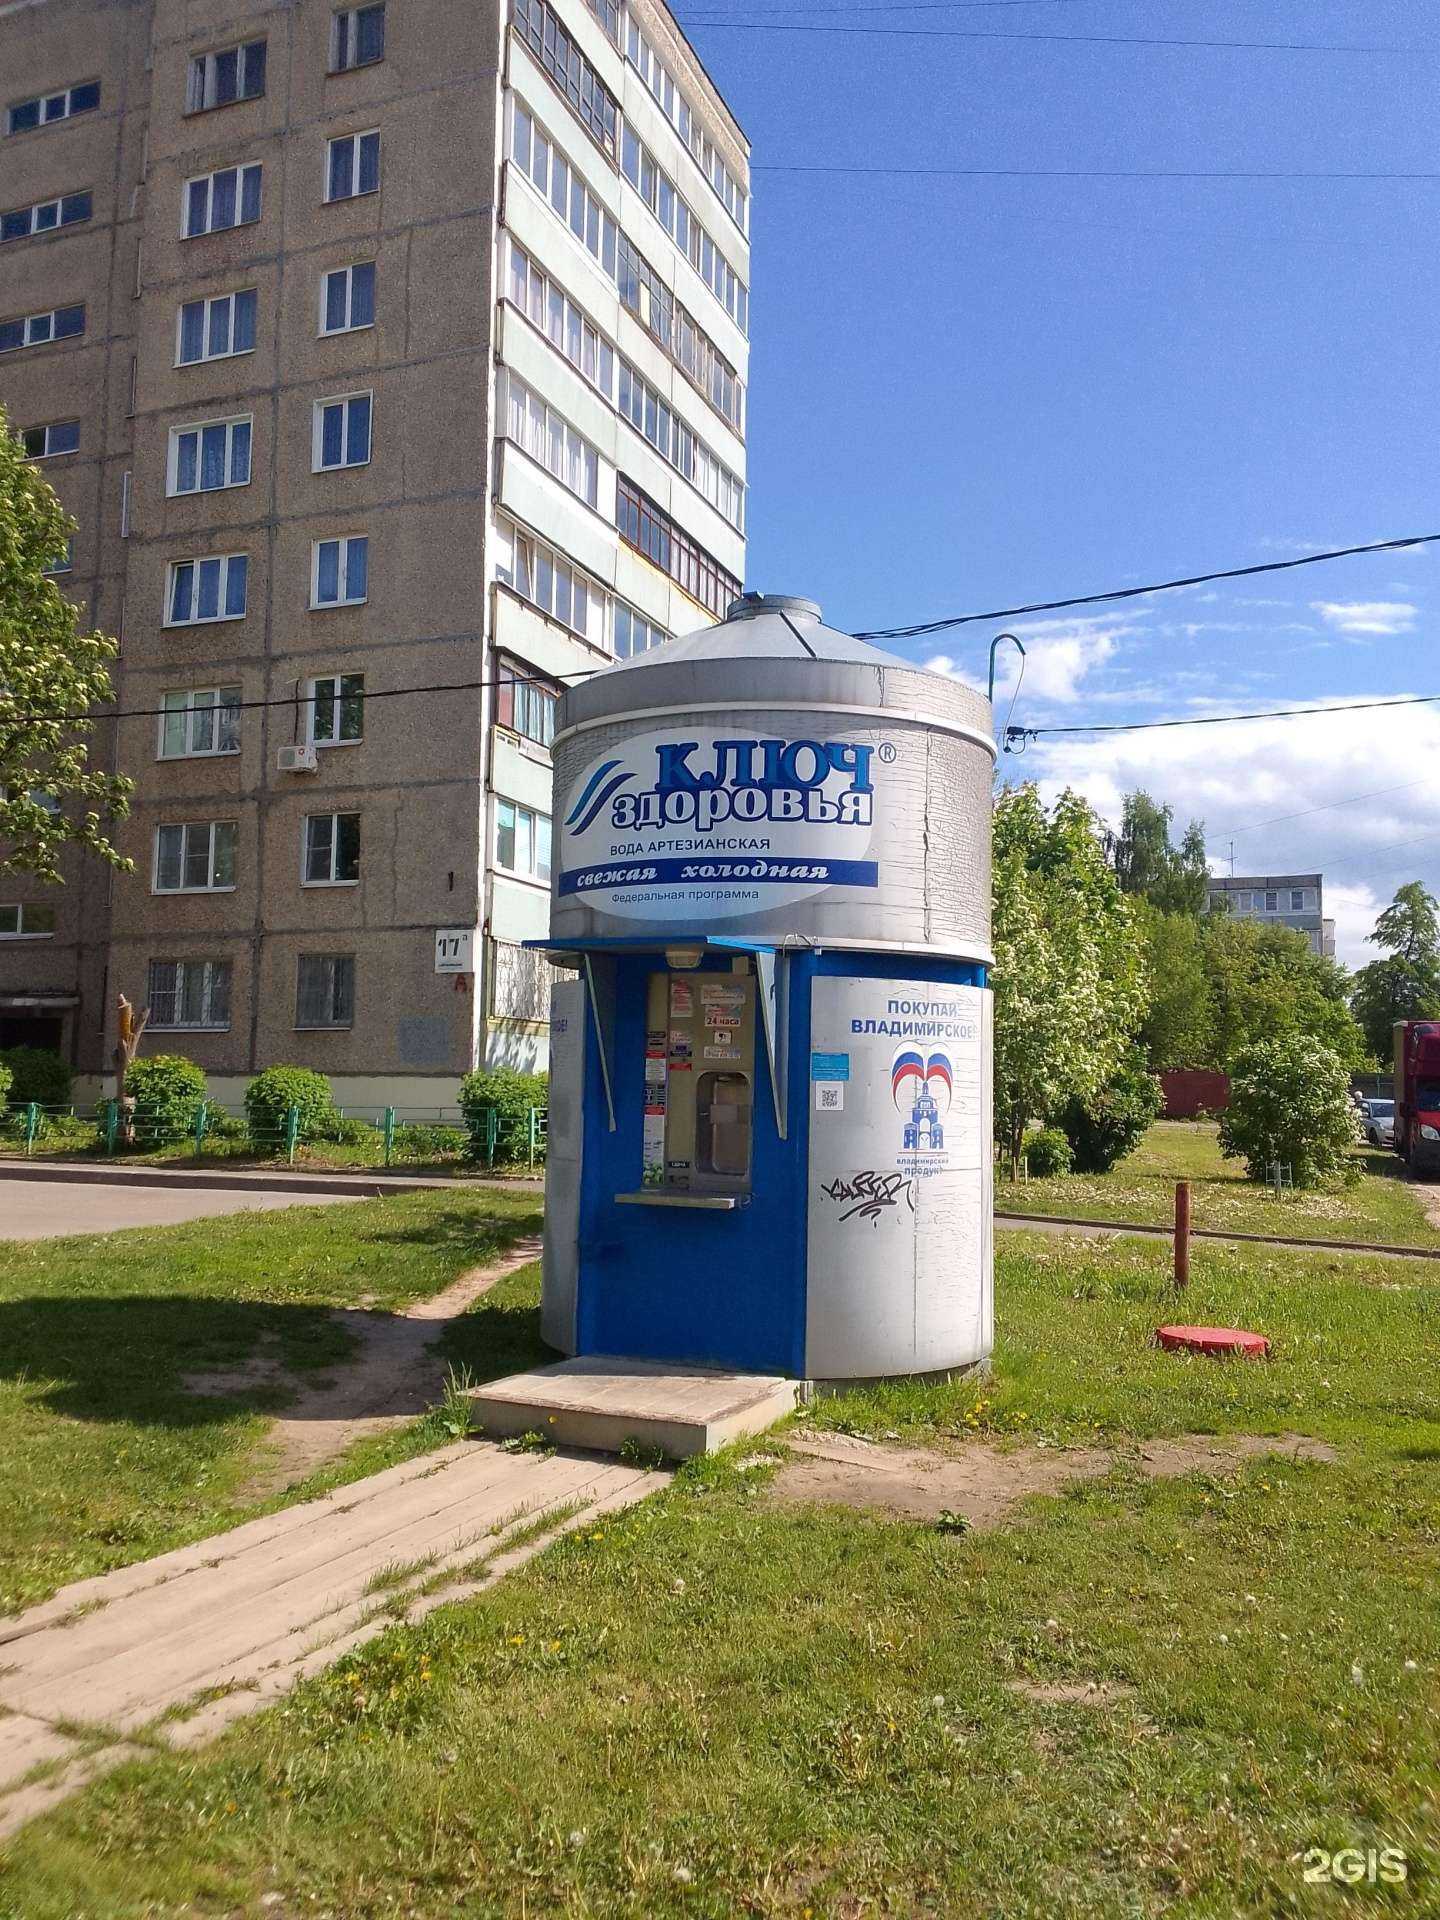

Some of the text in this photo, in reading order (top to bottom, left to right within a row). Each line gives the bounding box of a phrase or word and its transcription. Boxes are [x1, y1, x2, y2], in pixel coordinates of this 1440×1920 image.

[655, 739, 874, 793] КЛЮЧ
[610, 838, 771, 857] ВОДА АРТЕЗИАНСКАЯ
[577, 859, 829, 887] свежая холодная
[611, 888, 760, 903] Федеральная программа
